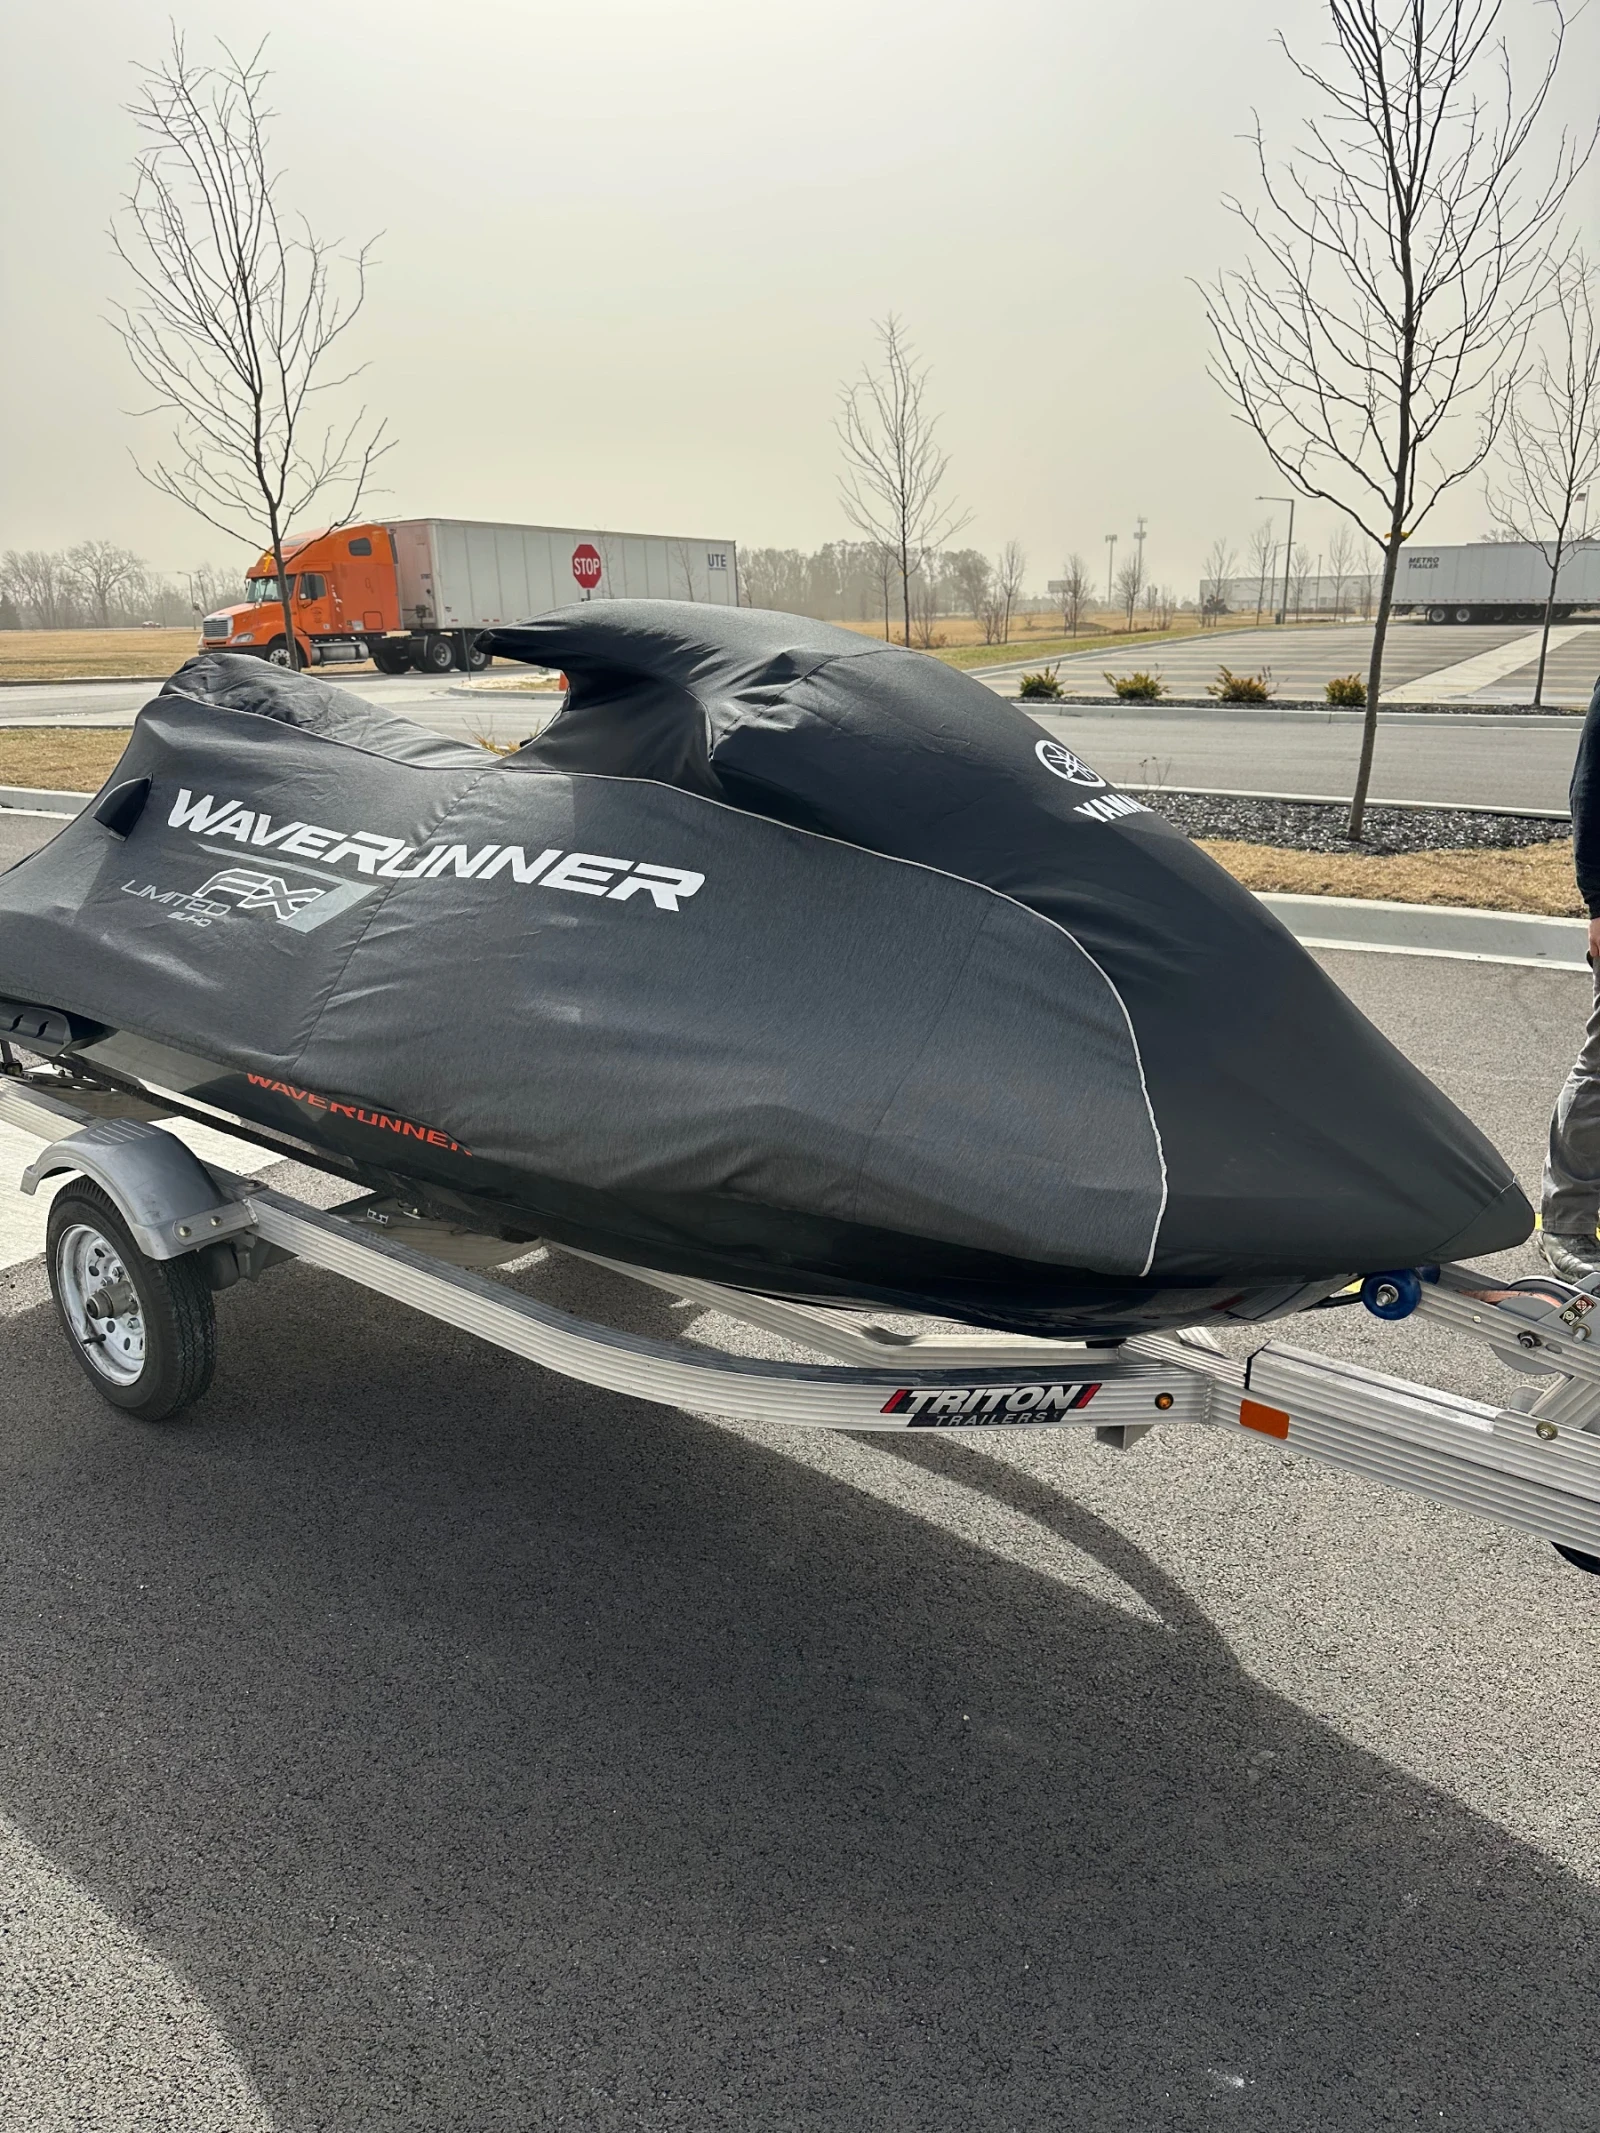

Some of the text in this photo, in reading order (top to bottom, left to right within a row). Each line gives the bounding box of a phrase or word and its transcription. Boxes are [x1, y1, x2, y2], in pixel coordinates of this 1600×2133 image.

[574, 558, 600, 575] STOP
[707, 553, 727, 567] UTE
[1408, 556, 1440, 564] METRO
[167, 788, 706, 912] WAVERUNNER
[120, 879, 231, 916] LIMITED
[191, 867, 326, 920] FX
[905, 1385, 1083, 1414] TRITON
[935, 1411, 1048, 1427] TRAILERS
